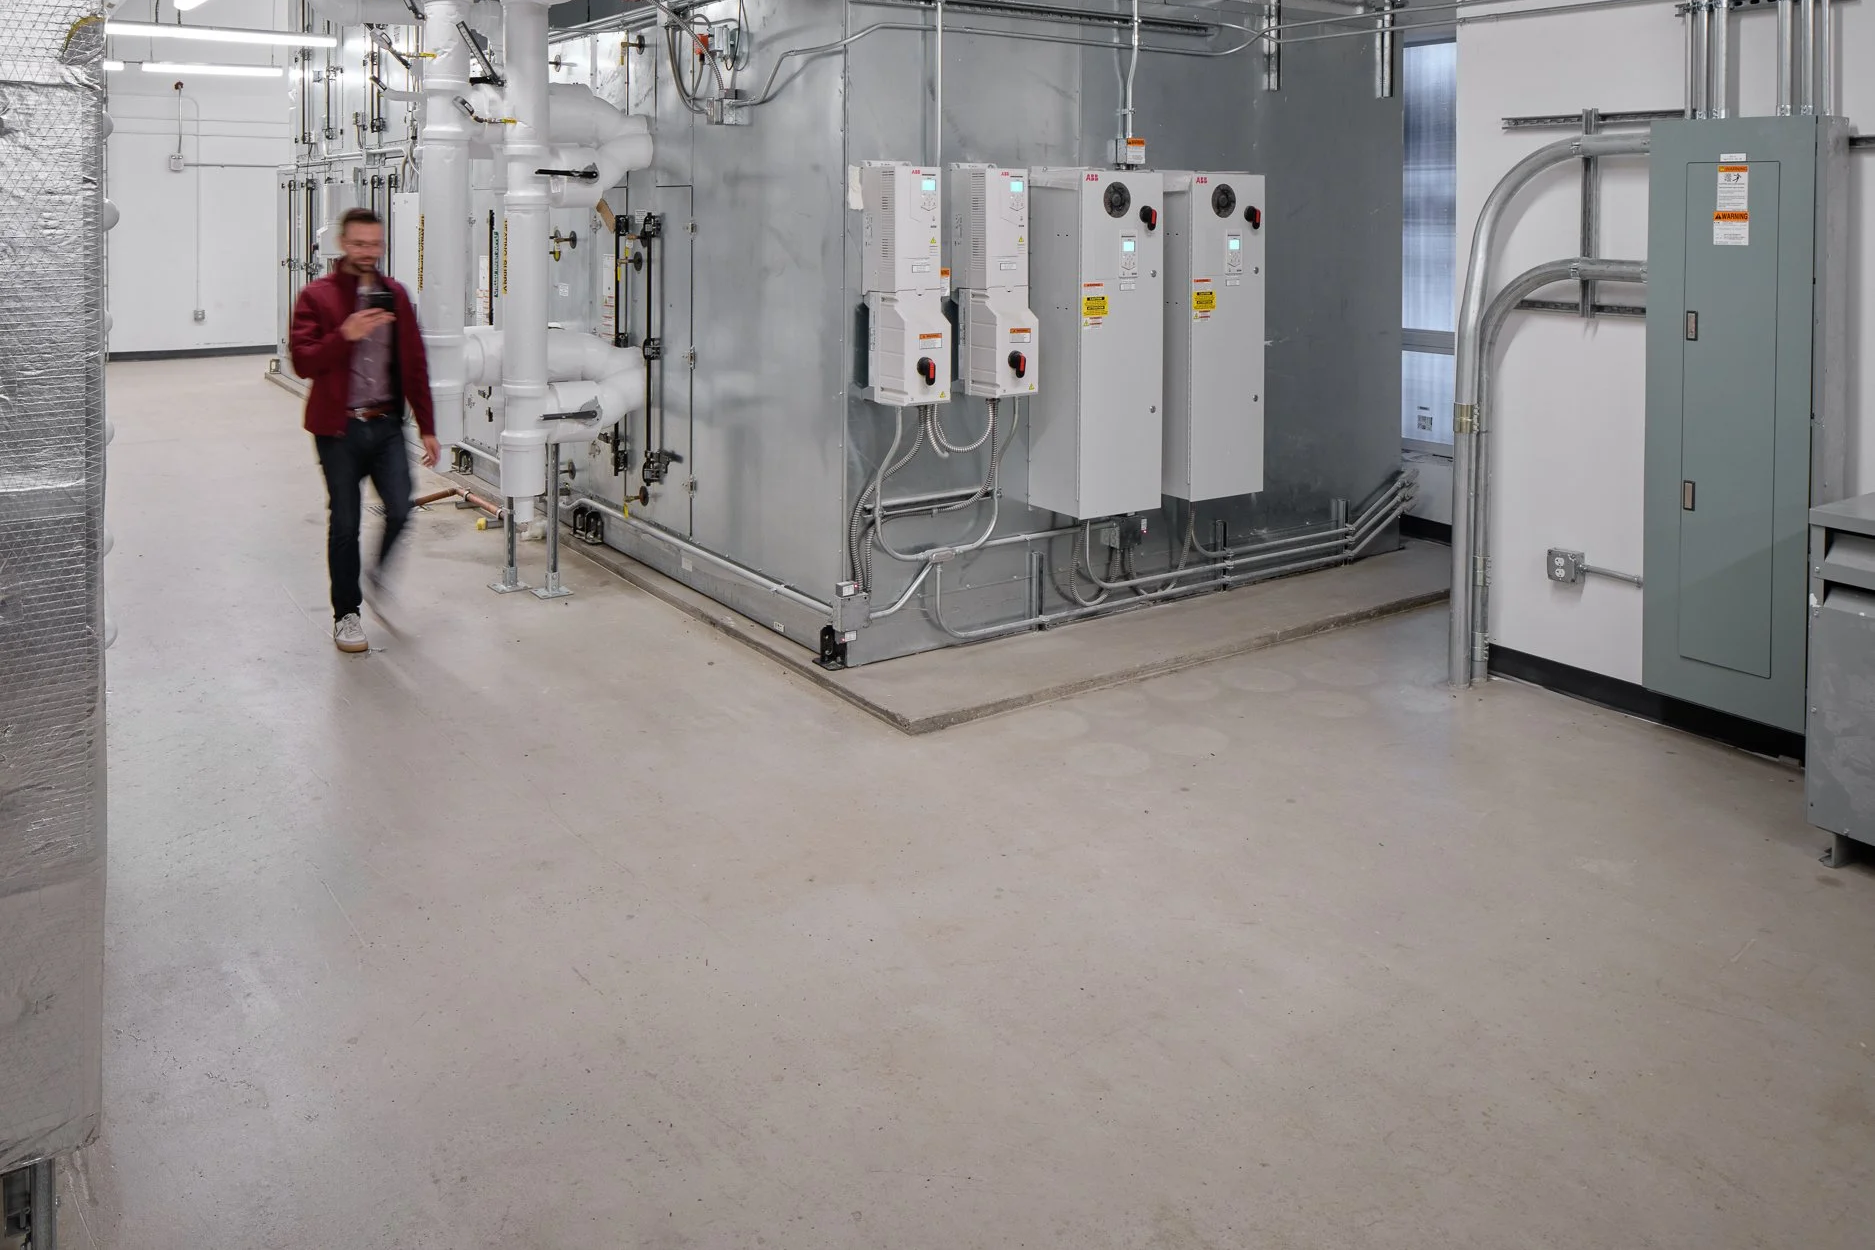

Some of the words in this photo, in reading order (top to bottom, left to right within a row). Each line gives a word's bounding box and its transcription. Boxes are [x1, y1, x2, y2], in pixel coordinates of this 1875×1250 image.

[1085, 173, 1099, 182] ABB
[1195, 176, 1208, 184] ABB
[1721, 212, 1748, 220] WARNING
